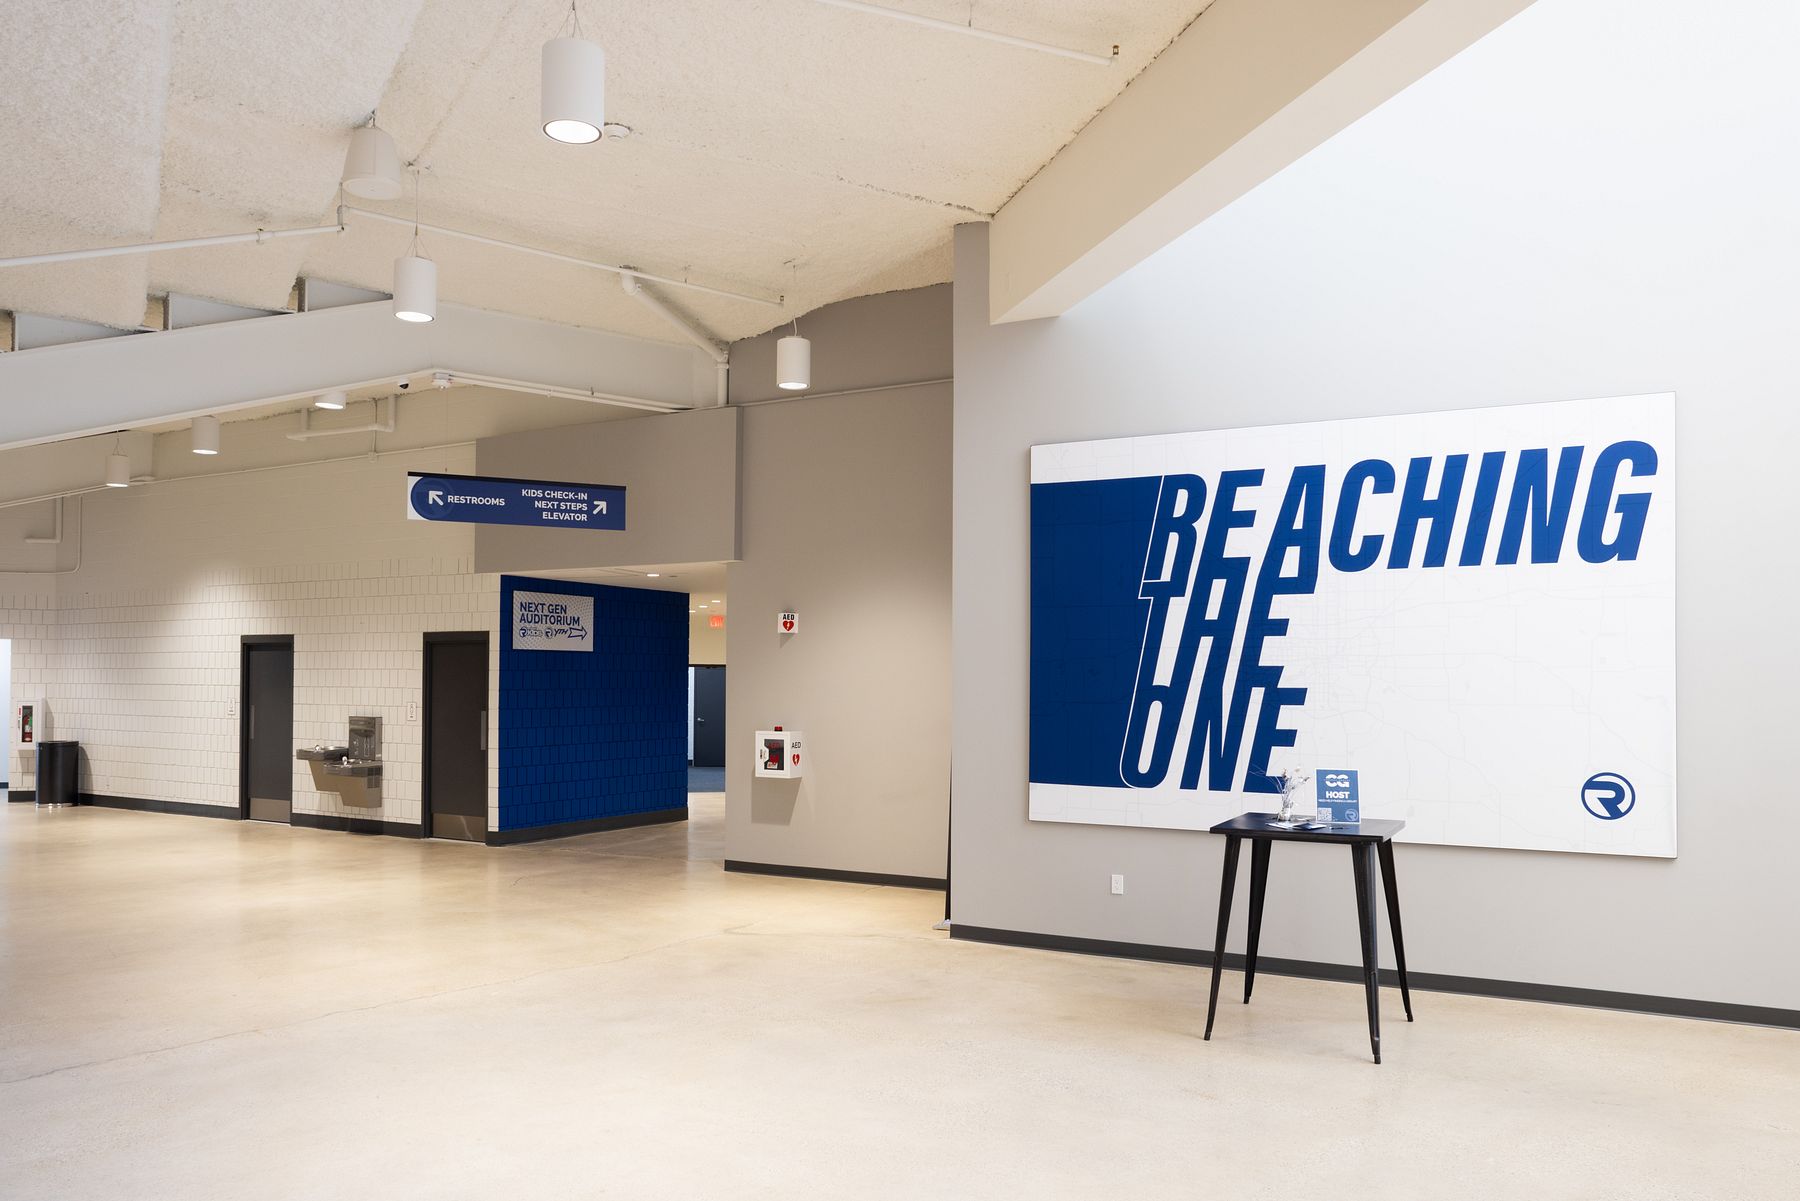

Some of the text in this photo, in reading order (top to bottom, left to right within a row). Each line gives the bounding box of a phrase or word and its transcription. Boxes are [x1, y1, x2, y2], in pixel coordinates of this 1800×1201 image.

[447, 495, 505, 506] RESTROOMS
[522, 488, 588, 501] KIDS CHECK-IN
[535, 501, 588, 512] NEXT STEPS
[1143, 440, 1658, 582] REACHING
[542, 512, 588, 522] ELEVATOR
[520, 602, 567, 614] NEXT GEN
[520, 614, 580, 626] AUDITORIUM
[1138, 577, 1315, 690] THE
[1120, 685, 1307, 794] ONE
[1326, 791, 1350, 799] HOST
